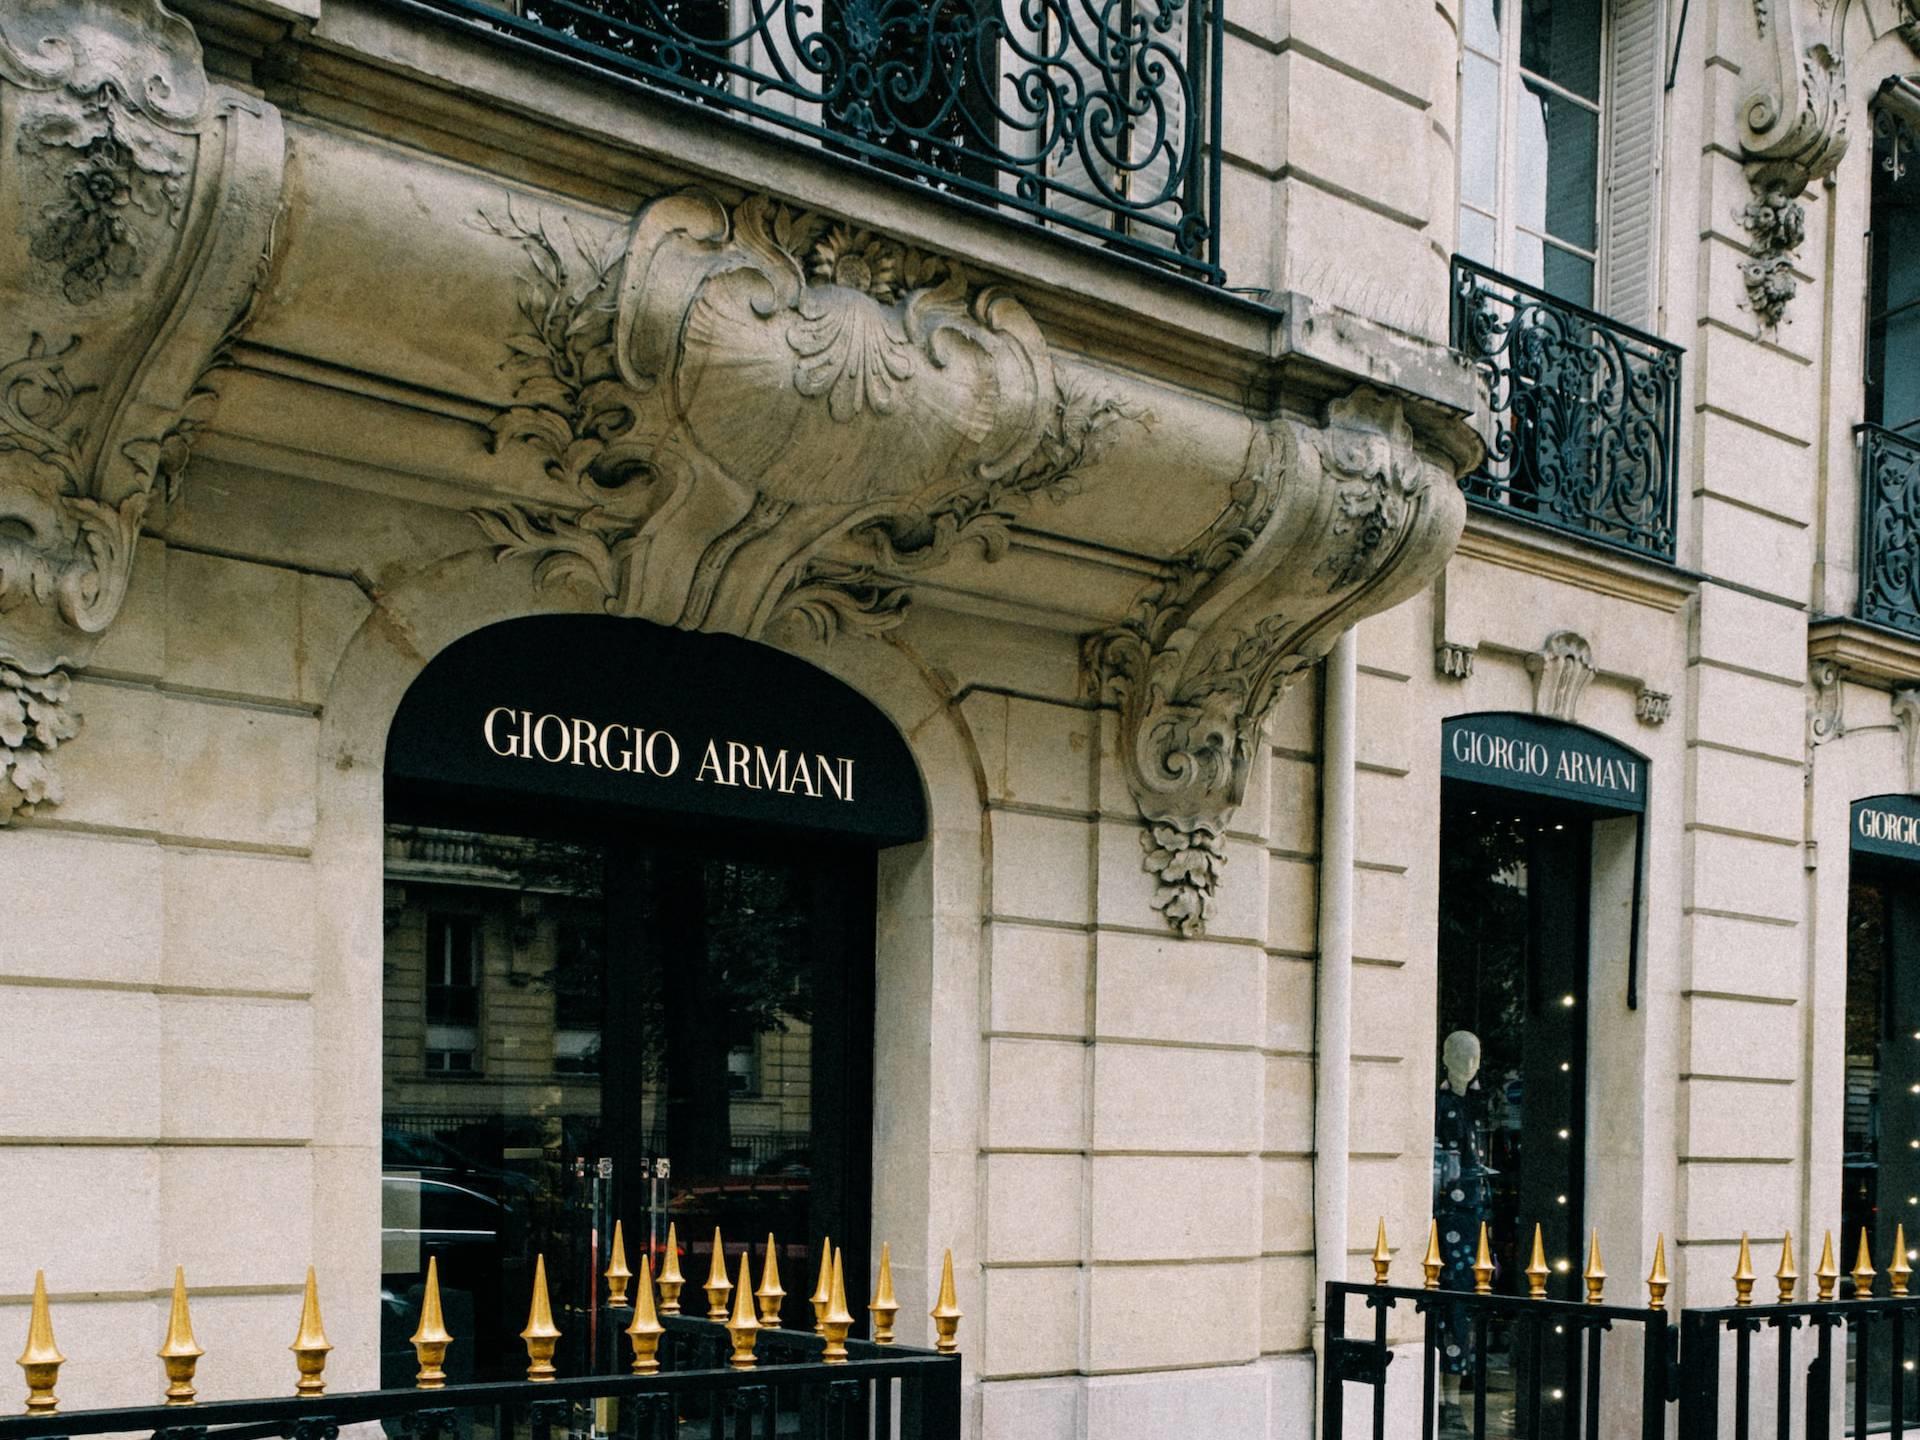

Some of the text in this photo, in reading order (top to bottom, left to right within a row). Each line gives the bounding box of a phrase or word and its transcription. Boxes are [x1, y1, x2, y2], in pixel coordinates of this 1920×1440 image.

[484, 707, 855, 801] GIORGIO ARMANI
[1452, 728, 1637, 793] GIORGIO ARMANI
